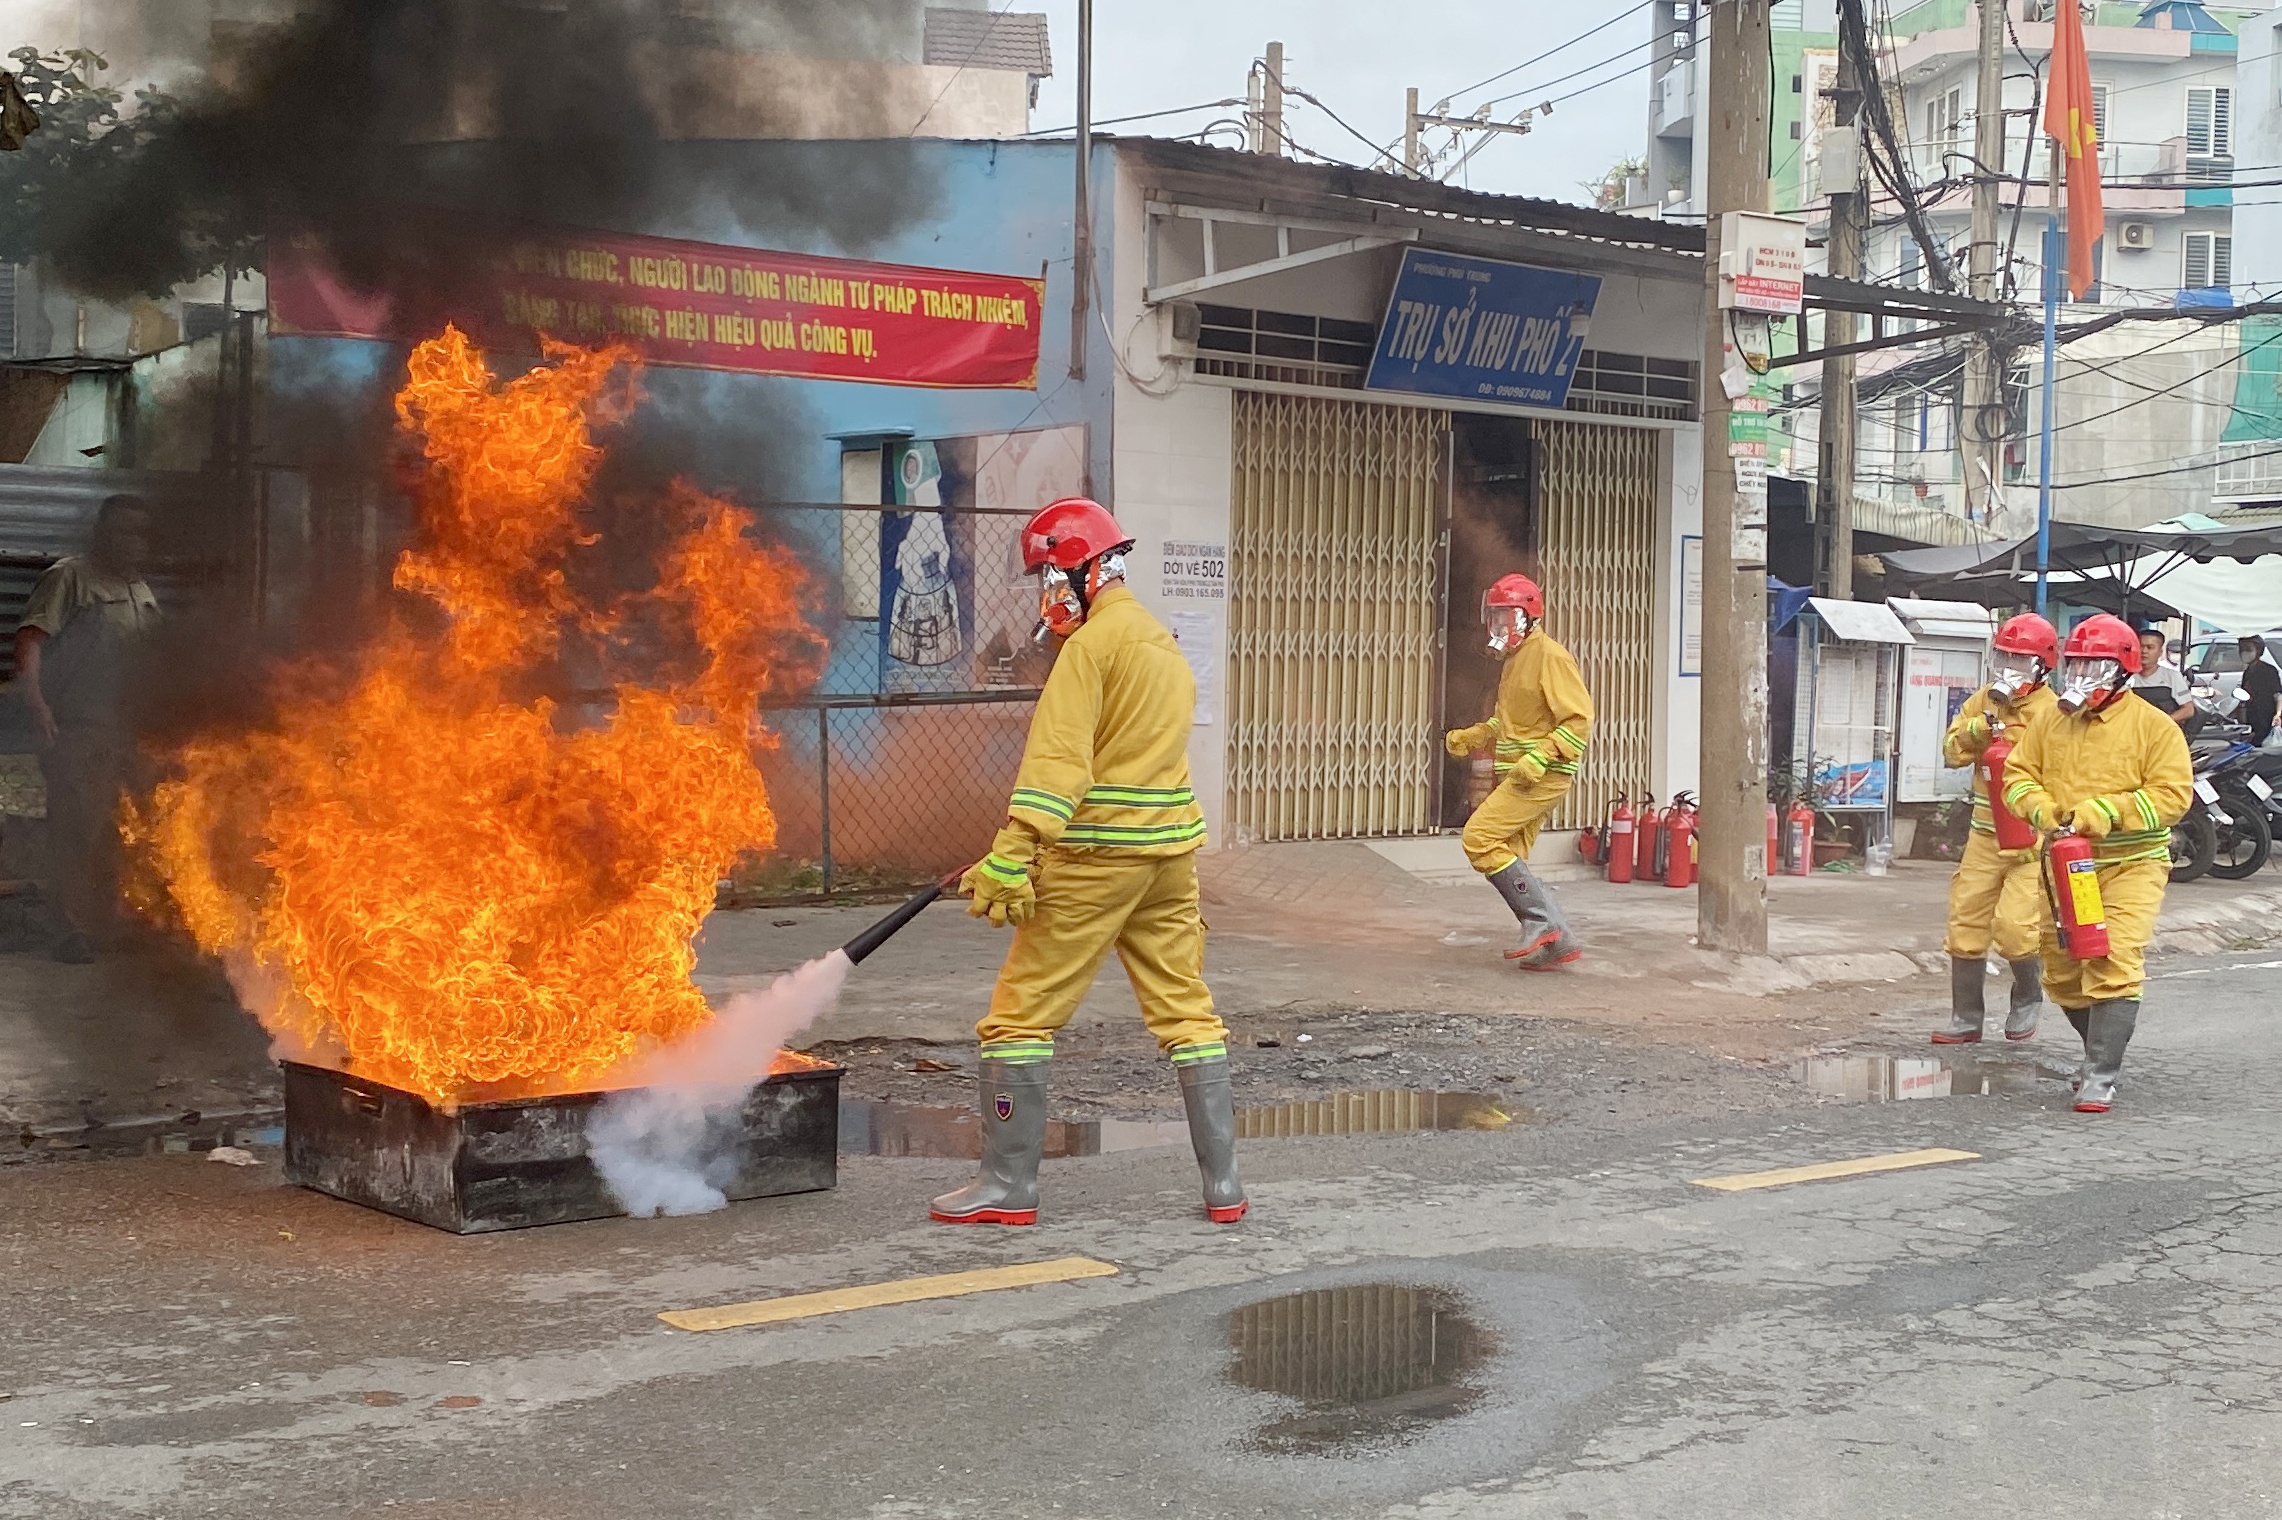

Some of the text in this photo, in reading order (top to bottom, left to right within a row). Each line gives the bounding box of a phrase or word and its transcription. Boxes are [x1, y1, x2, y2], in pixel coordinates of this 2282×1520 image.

[567, 247, 625, 287] CHỨC,
[629, 254, 688, 291] NGƯỜI
[692, 263, 727, 294] LAO
[731, 263, 780, 304] ĐỘNG
[784, 269, 845, 308] NGÀNH
[848, 279, 871, 310] TƯ
[873, 281, 917, 315] PHÁP
[920, 286, 972, 323] TRÁCH
[975, 293, 1029, 331] NHIỆM,
[1759, 279, 1800, 293] INTERNET
[612, 303, 661, 342] THỰC
[665, 306, 709, 348] HIỆN
[714, 310, 756, 352] HIỆU
[760, 311, 796, 352] QUẢ
[800, 319, 847, 355] CÔNG
[850, 329, 878, 363] VỤ.
[1388, 299, 1440, 374] TRỤ
[1434, 285, 1477, 364] SỞ
[1466, 310, 1520, 371] KHU
[1511, 305, 1573, 376] PHỐ
[1731, 443, 1754, 456] 0962
[1201, 560, 1224, 578] 502
